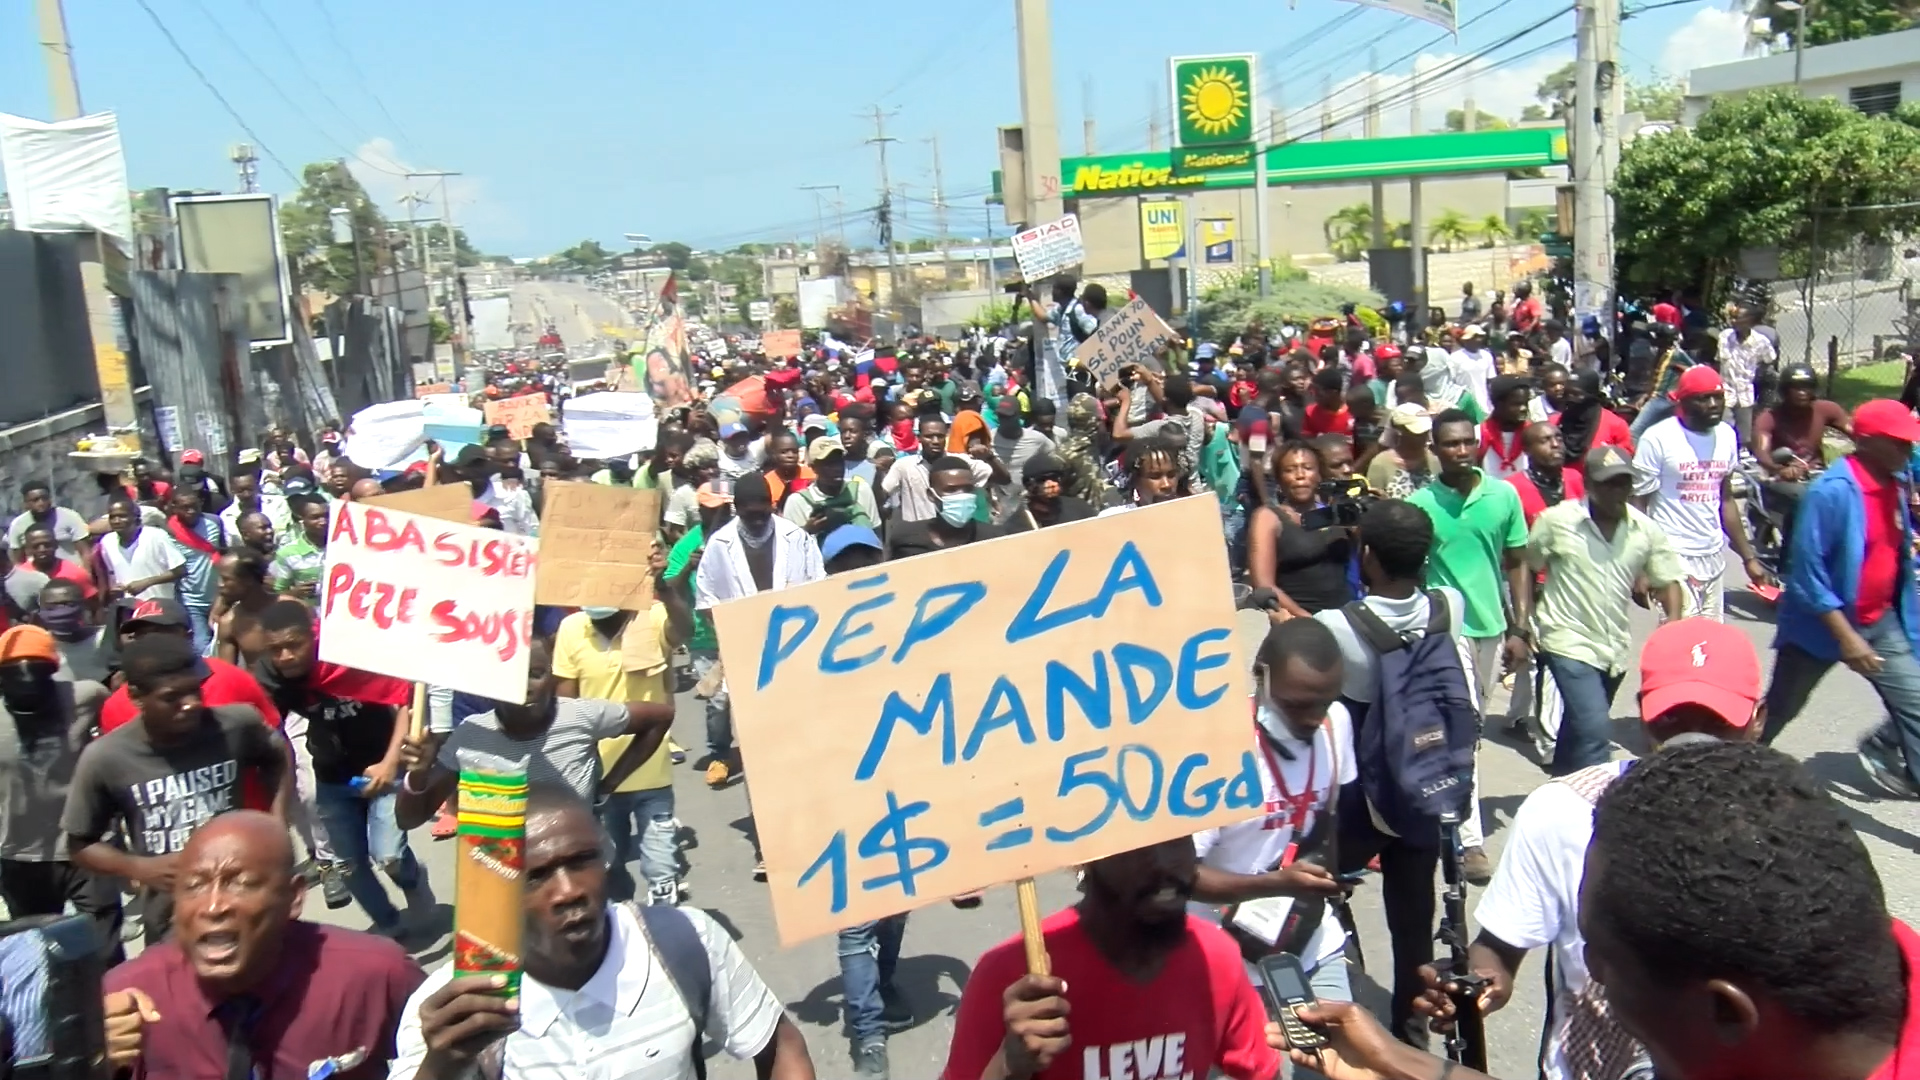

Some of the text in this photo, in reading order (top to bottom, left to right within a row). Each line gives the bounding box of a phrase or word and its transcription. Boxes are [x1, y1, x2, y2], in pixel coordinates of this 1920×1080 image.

[1184, 150, 1250, 168] National
[1147, 208, 1177, 225] UNI
[1097, 311, 1131, 343] BANK
[1088, 348, 1108, 371] SE
[1098, 335, 1146, 382] KORIJE
[325, 562, 418, 630] PEZE
[1006, 541, 1163, 643] LA
[854, 628, 1232, 782] MANDE
[131, 759, 238, 806] I PAUSED
[141, 784, 234, 829] MY GAME
[468, 846, 520, 880] Spaghetti
[797, 791, 949, 914] 1$
[1083, 1032, 1187, 1080] LEVE
